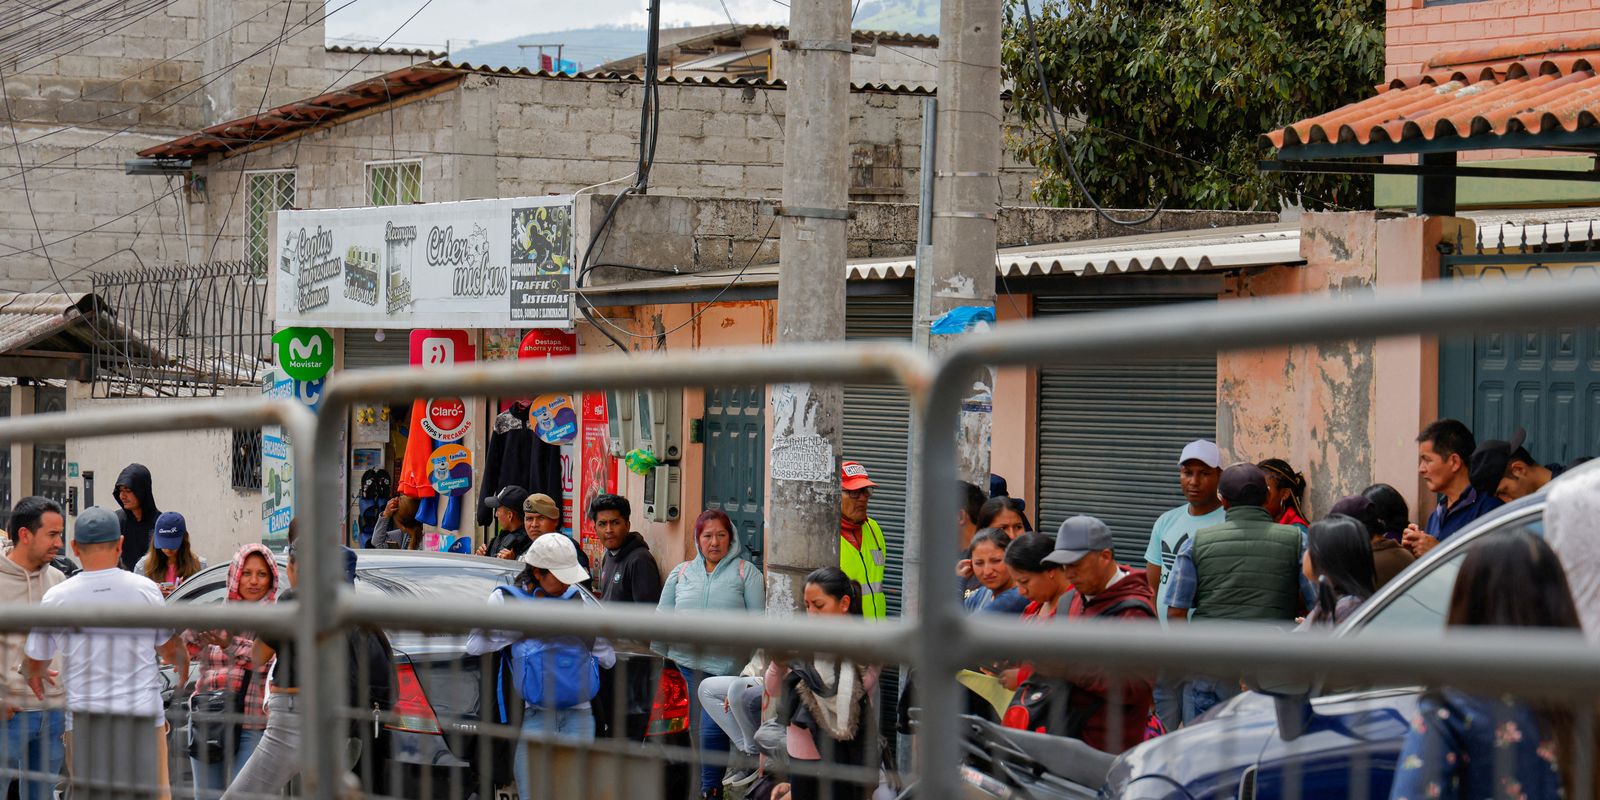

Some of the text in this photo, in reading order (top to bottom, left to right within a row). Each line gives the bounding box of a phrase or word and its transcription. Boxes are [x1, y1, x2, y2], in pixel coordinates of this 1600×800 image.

[297, 225, 333, 267] Copias
[385, 220, 417, 247] Recargas
[426, 225, 468, 267] Ciber
[297, 256, 341, 290] Impresiones
[453, 251, 508, 298] michus
[344, 276, 379, 306] Internet
[521, 293, 569, 304] SISTEMAS
[431, 405, 459, 416] Claro
[422, 420, 437, 436] CHIPS
[442, 421, 472, 440] RECARGAS
